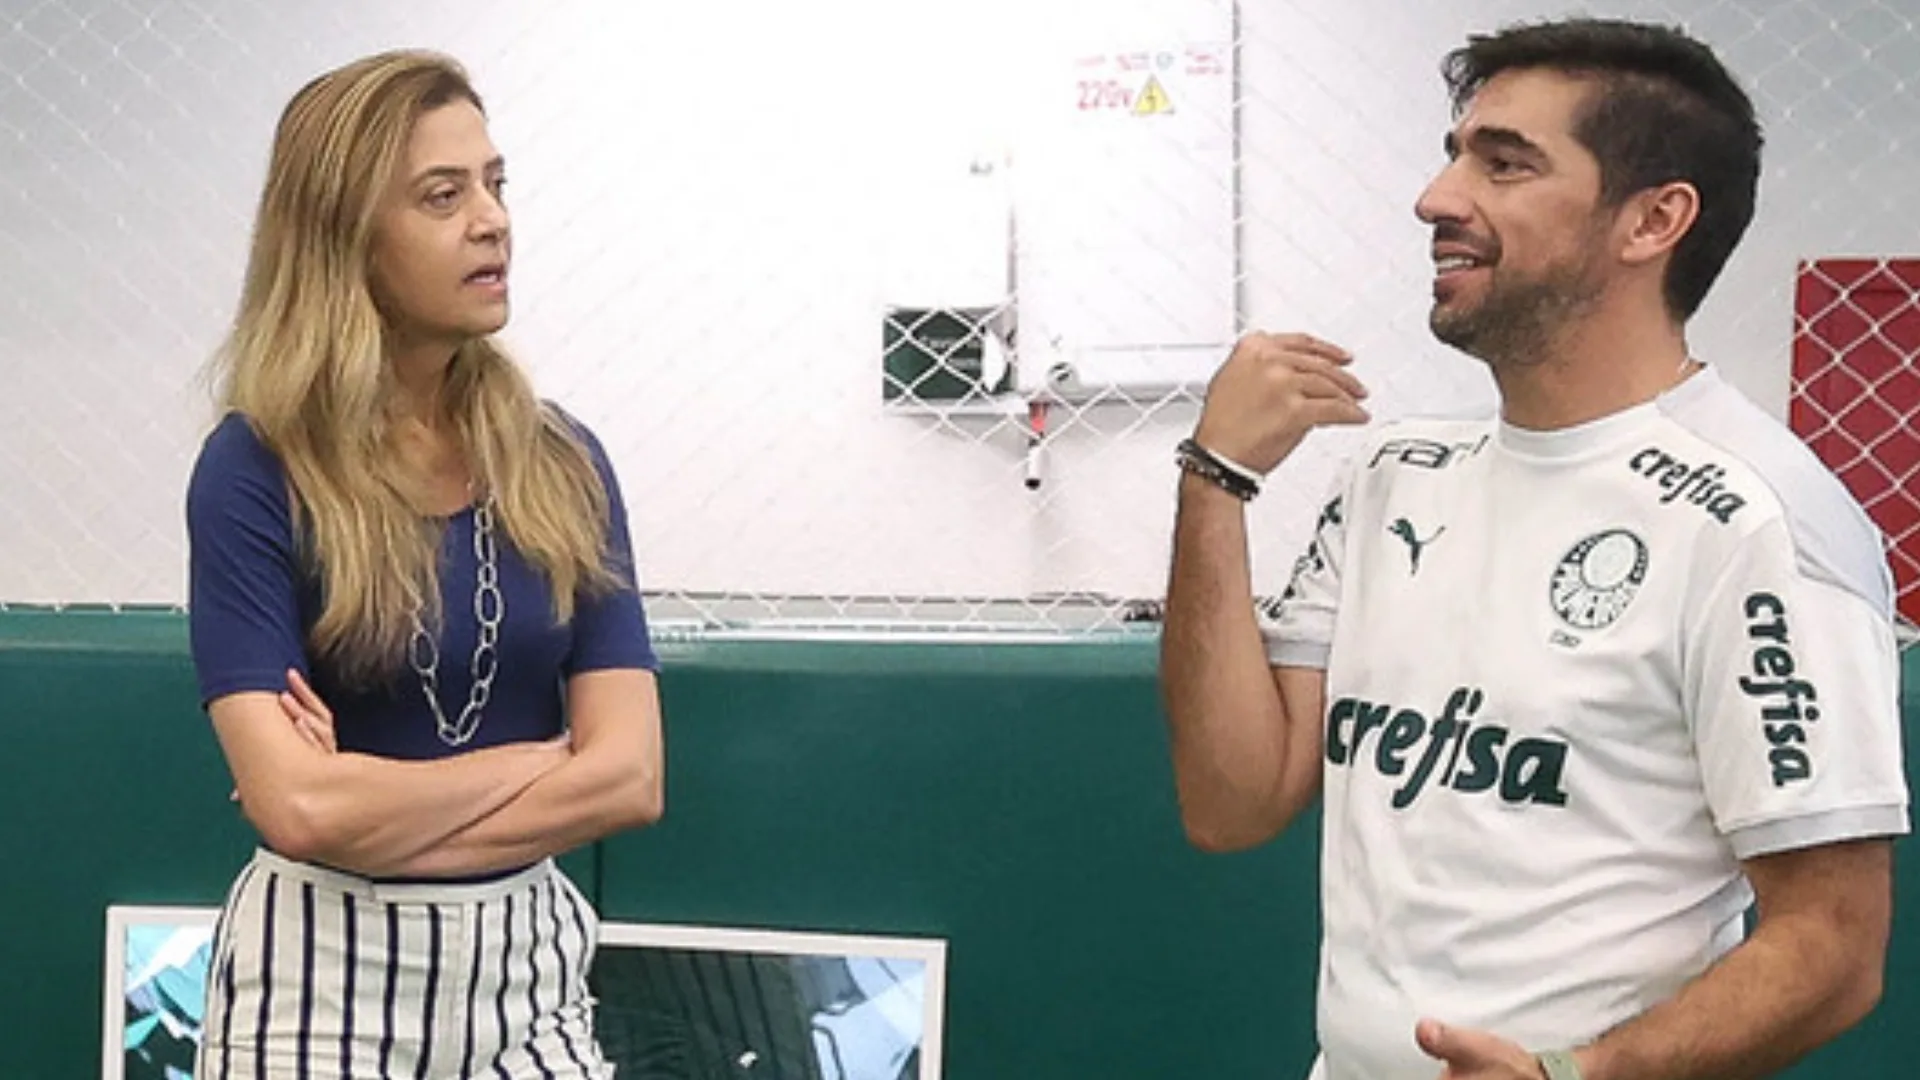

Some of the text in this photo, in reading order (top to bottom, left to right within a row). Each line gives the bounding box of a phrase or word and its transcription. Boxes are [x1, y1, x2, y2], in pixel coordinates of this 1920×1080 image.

[1629, 447, 1746, 524] crefisa
[1327, 687, 1568, 809] crefisa
[1738, 592, 1820, 787] crefisa
